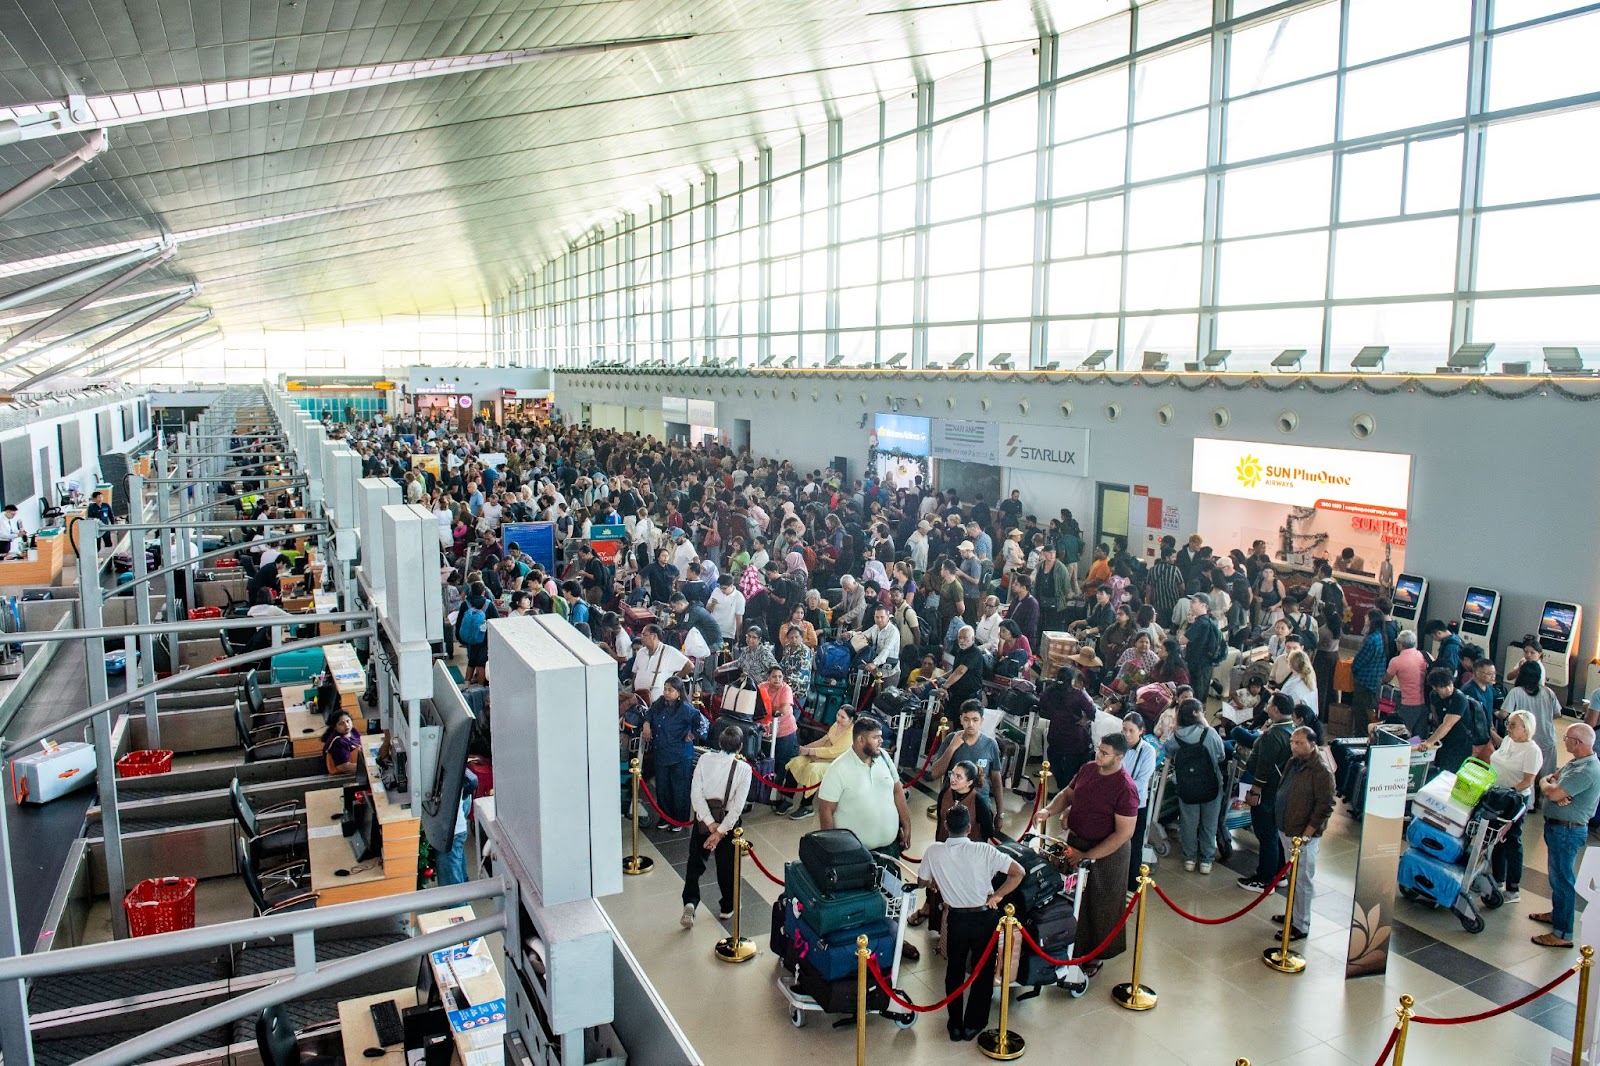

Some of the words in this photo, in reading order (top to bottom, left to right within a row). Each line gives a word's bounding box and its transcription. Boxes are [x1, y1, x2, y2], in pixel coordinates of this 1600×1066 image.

[1020, 446, 1076, 465] STARLUX
[1265, 465, 1291, 479] SUN
[1293, 468, 1352, 486] PhuQuoc
[1265, 479, 1294, 488] AIRWAYS
[1351, 516, 1380, 533] SUN
